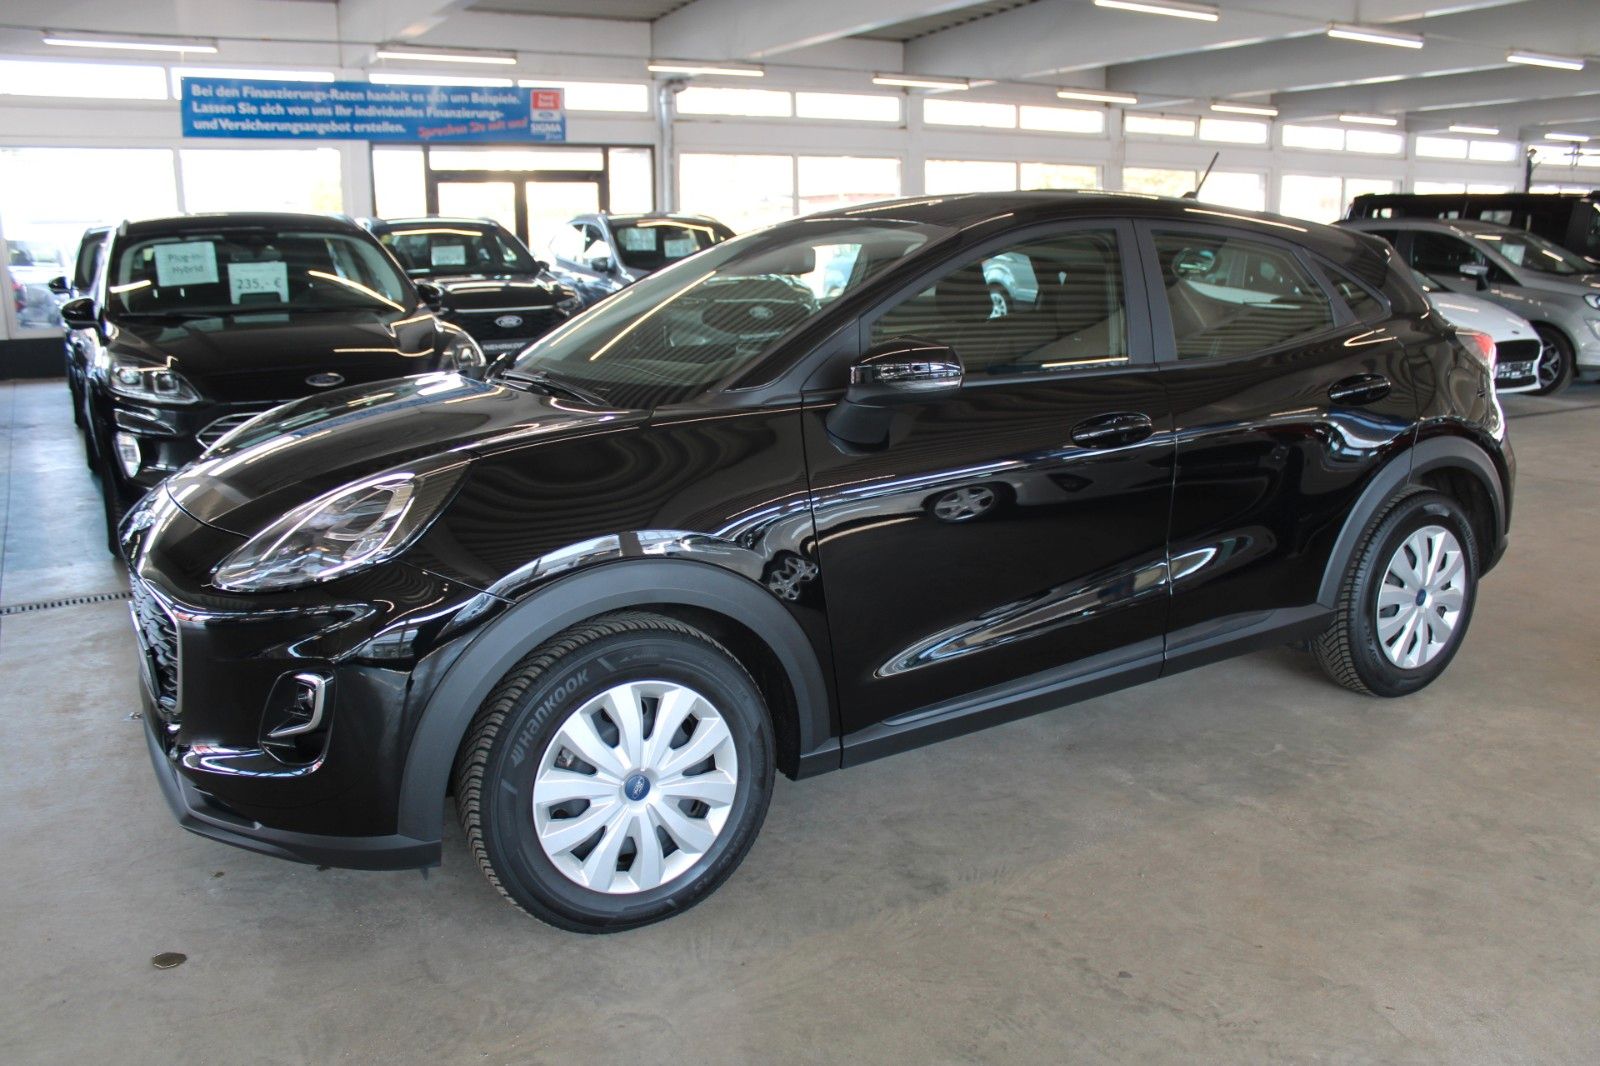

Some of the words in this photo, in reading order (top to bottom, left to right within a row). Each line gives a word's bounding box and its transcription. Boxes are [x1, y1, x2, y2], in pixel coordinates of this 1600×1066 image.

[191, 84, 213, 97] Bei
[216, 85, 240, 98] den
[242, 86, 364, 103] Finanzierungs-Raten
[367, 90, 409, 102] handelt
[412, 93, 425, 102] es
[450, 94, 468, 104] um
[471, 92, 521, 107] Beispiele.
[192, 101, 236, 114] Lassen
[238, 102, 258, 115] Sie
[260, 103, 285, 116] sich
[287, 106, 310, 116] von
[311, 106, 333, 117] uns
[335, 104, 353, 117] Ihr
[355, 104, 424, 118] individuelles
[426, 105, 504, 121] Finanzierungs-
[193, 119, 218, 131] und
[218, 118, 350, 135] Versicherungsangebot
[353, 121, 406, 133] erstellen.
